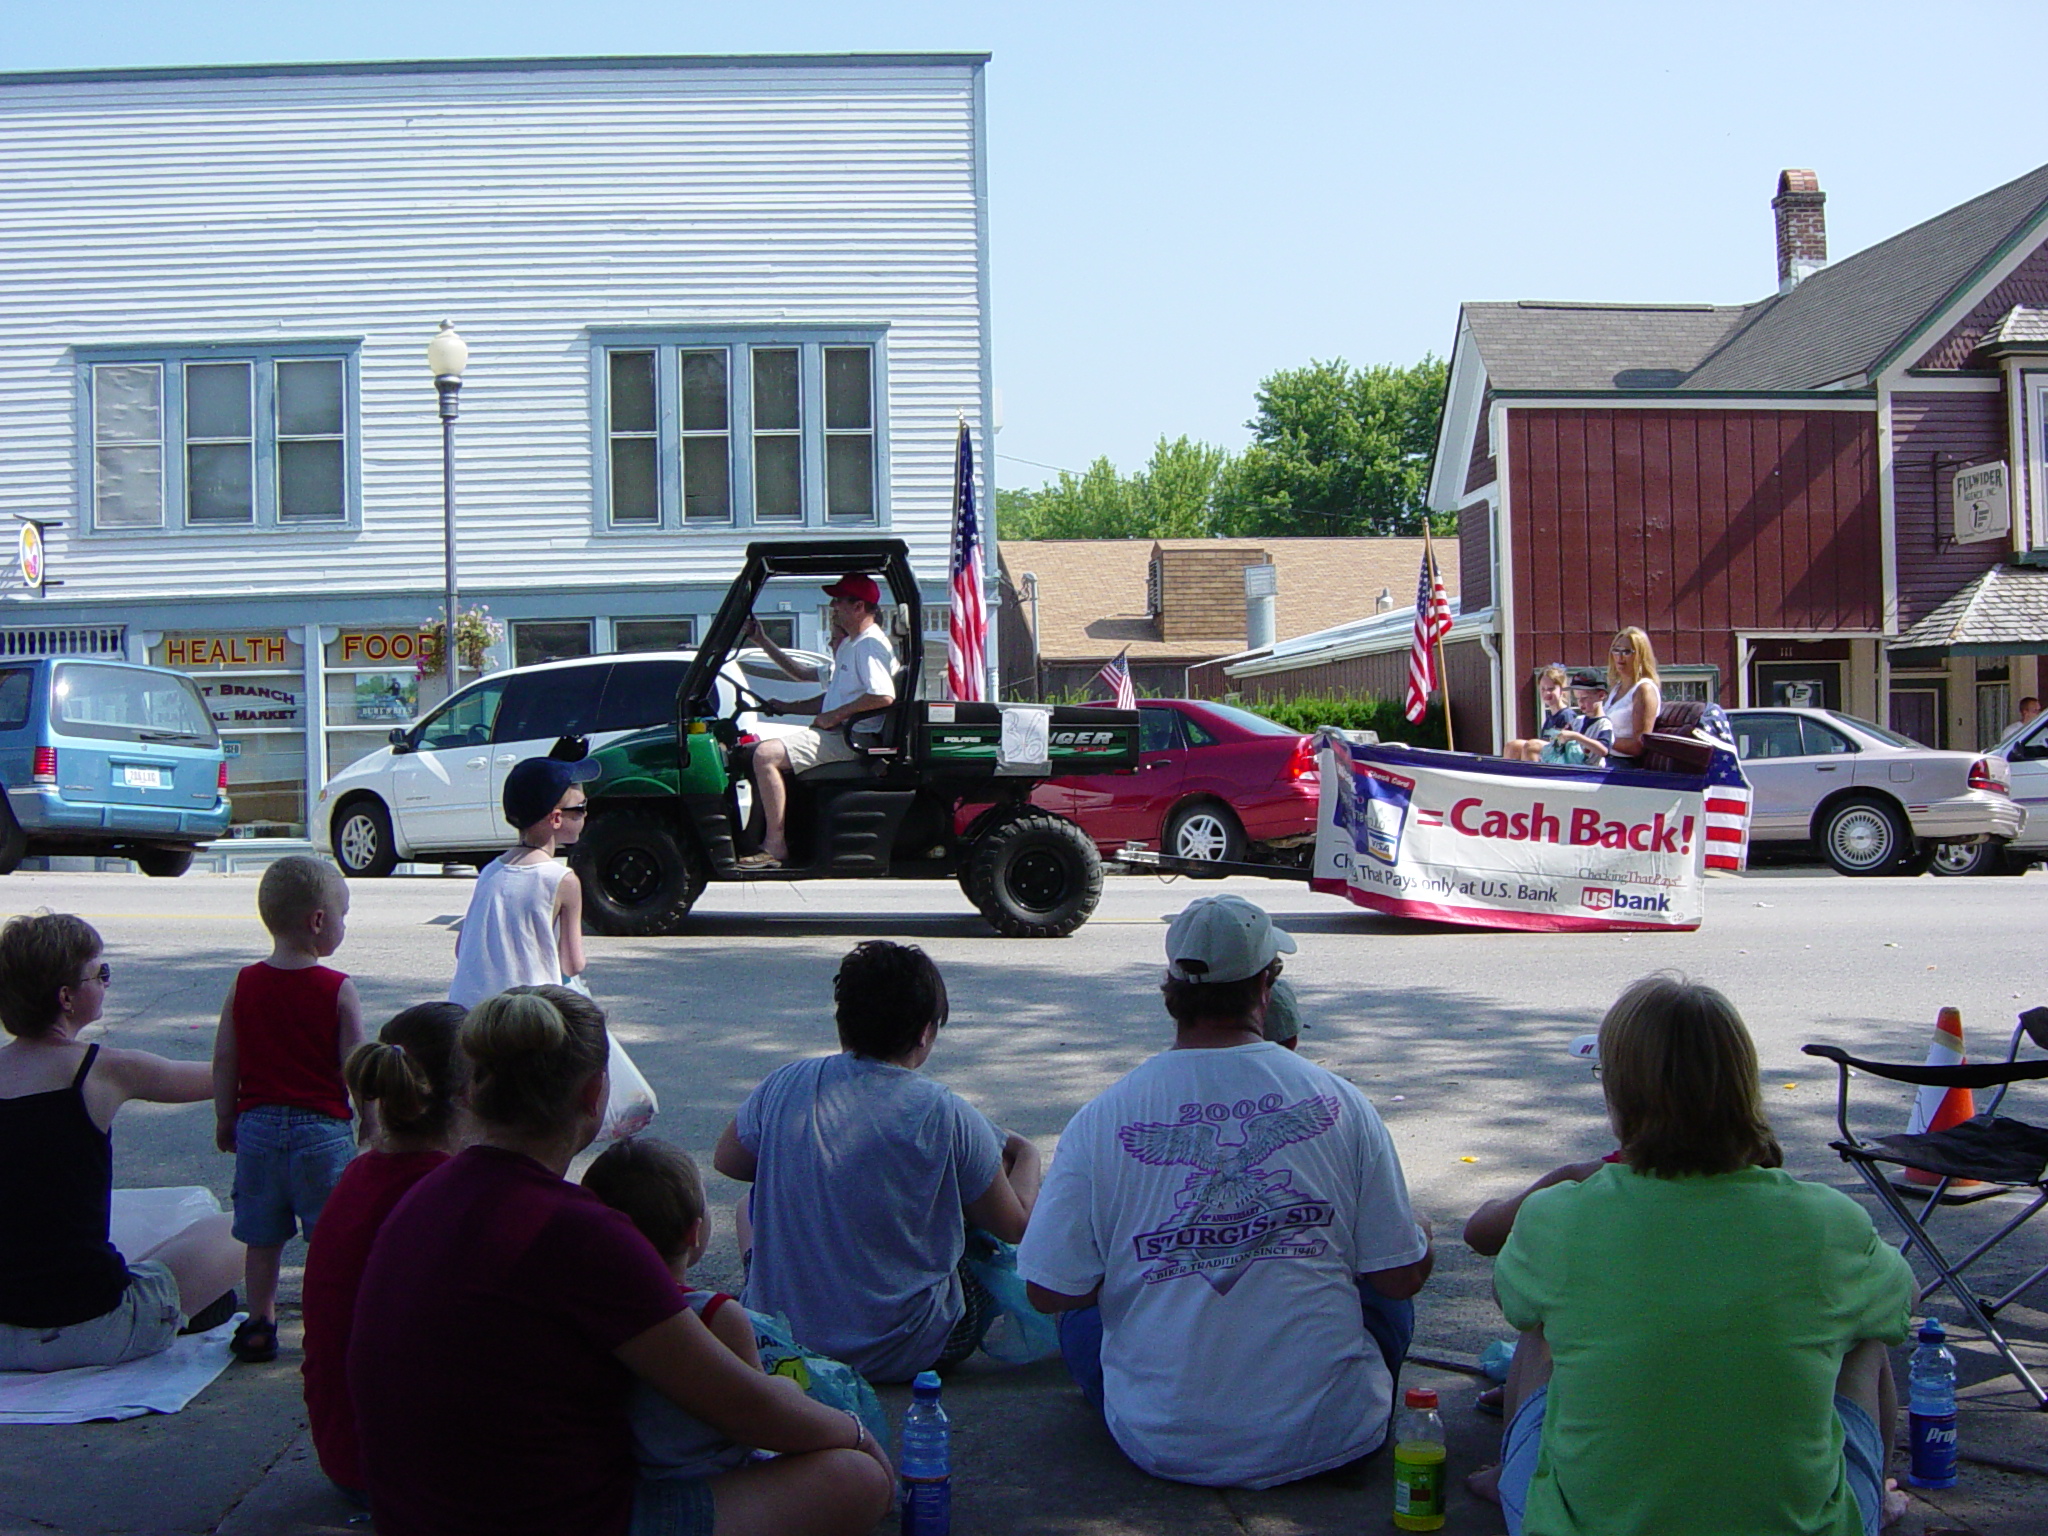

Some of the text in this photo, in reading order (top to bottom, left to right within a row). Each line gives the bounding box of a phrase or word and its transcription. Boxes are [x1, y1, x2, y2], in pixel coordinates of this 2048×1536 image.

[1957, 469, 2003, 498] FULWIDER
[165, 637, 286, 665] HEALTH
[220, 684, 296, 706] BRANCH
[234, 710, 297, 721] MARKET
[1450, 797, 1560, 844] Cash
[1569, 807, 1694, 855] Back!
[1372, 839, 1390, 853] VISA
[1358, 865, 1383, 884] That
[1386, 872, 1417, 891] Pays
[1422, 877, 1455, 897] only
[1459, 881, 1475, 896] at
[1481, 881, 1512, 899] U.S.
[1518, 884, 1558, 903] Bank
[1178, 1093, 1283, 1122] 2000
[1147, 1206, 1323, 1255] STURGIS, SD
[1157, 1266, 1187, 1280] BIKER
[1190, 1252, 1251, 1271] TRADITION
[1253, 1246, 1288, 1257] SINCE
[1293, 1247, 1317, 1256] 1940
